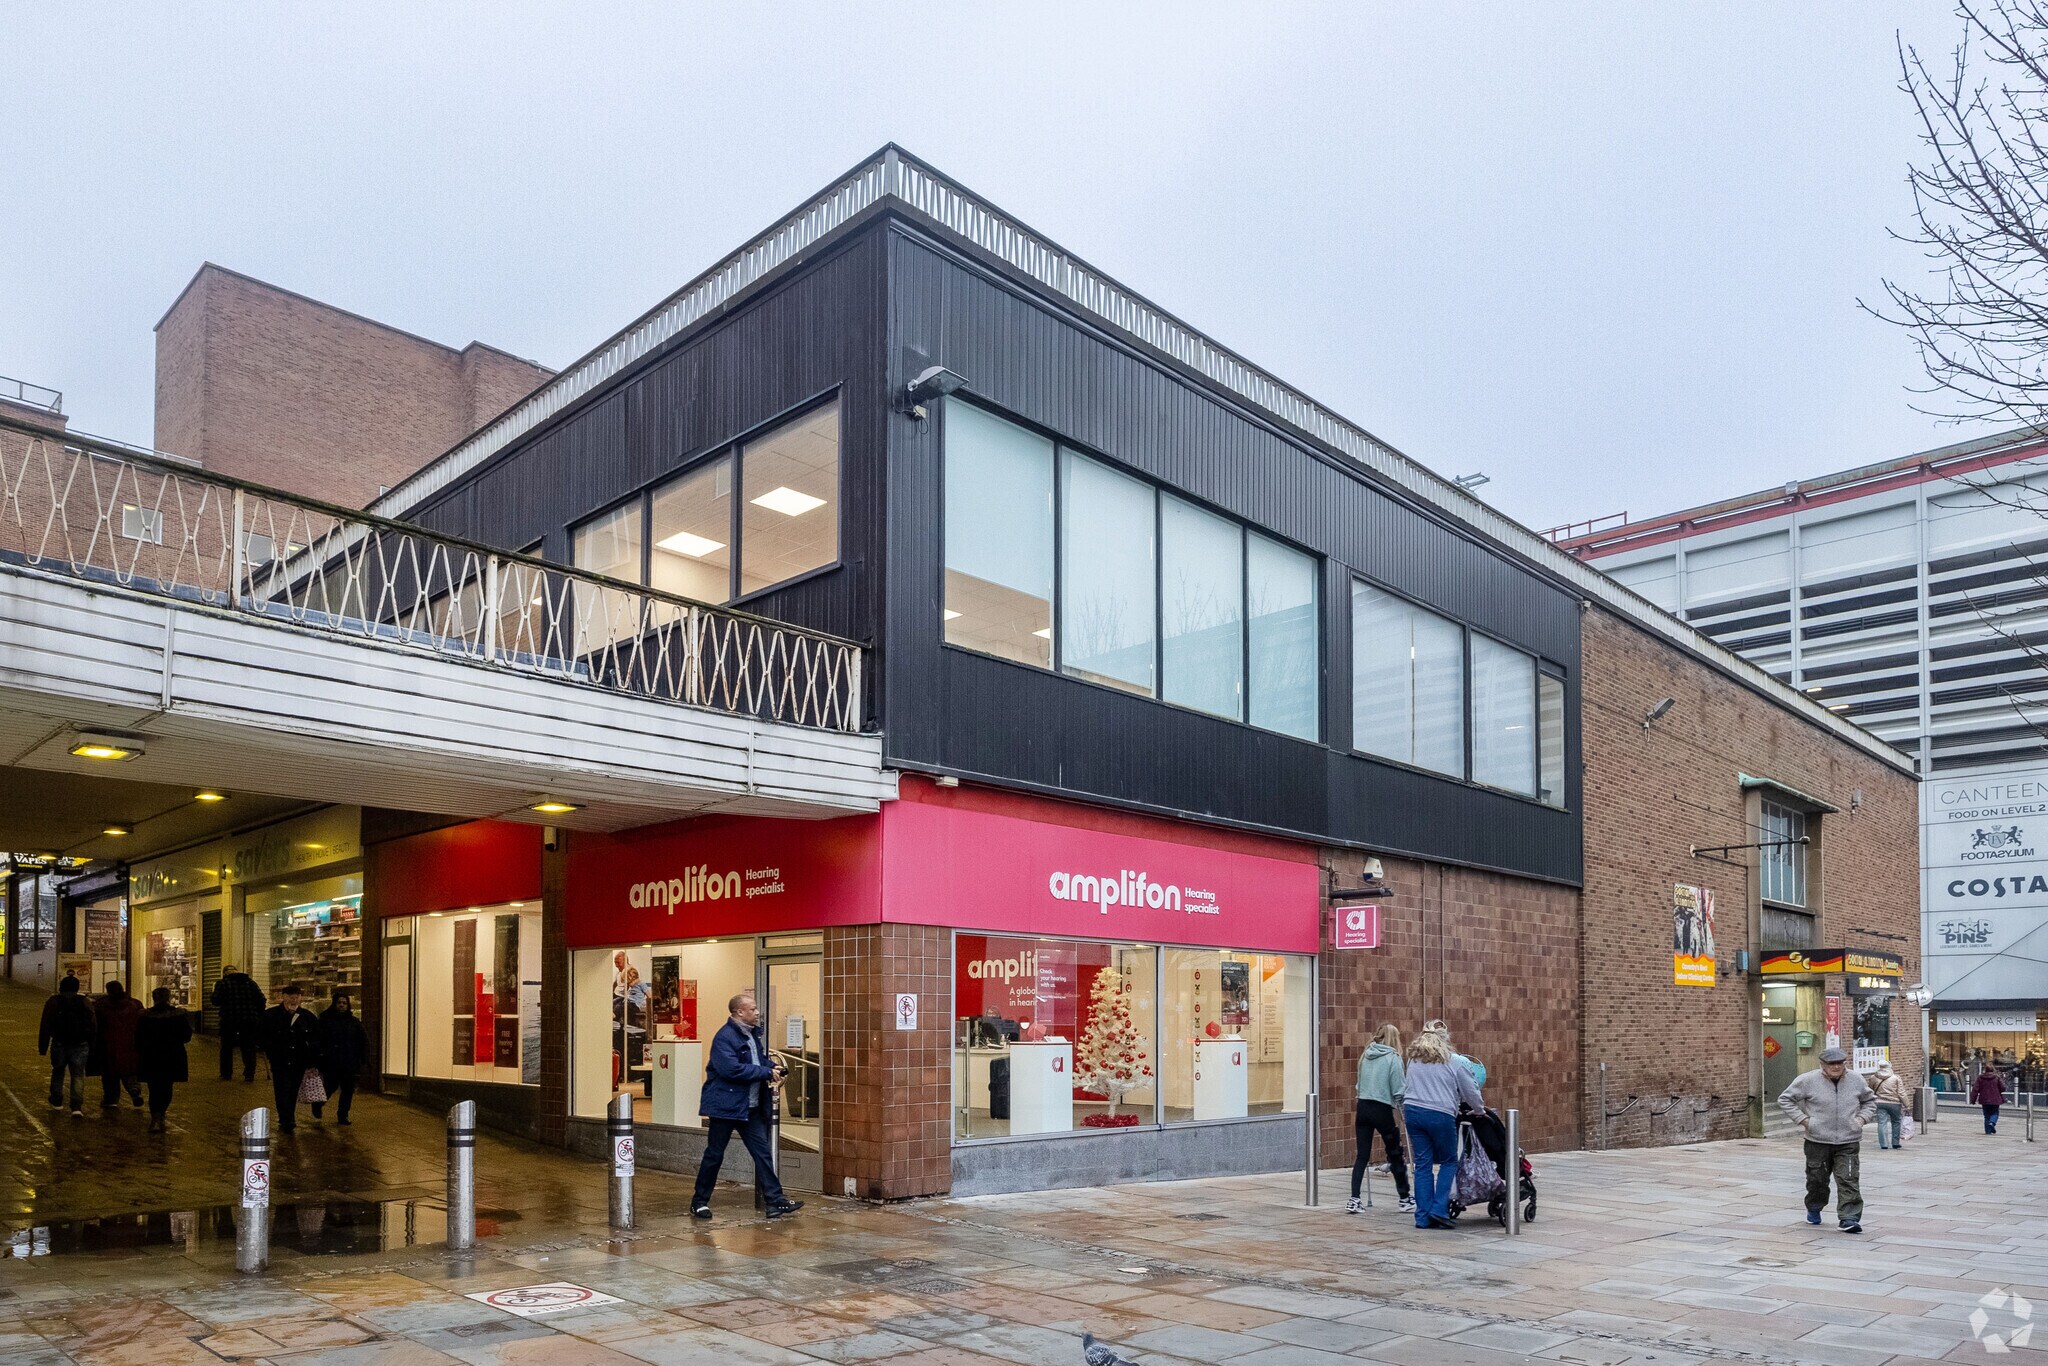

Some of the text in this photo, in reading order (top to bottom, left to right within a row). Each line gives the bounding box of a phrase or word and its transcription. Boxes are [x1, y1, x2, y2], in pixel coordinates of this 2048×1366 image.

[1941, 782, 2048, 804] CANTEEN
[1949, 804, 2046, 819] FOOD ON LEVEL 2
[14, 855, 47, 865] VAPES
[1961, 848, 2034, 860] FOOTASYLUM
[745, 866, 780, 880] Hearing
[629, 864, 741, 915] amplifon
[745, 882, 785, 899] specialist
[1049, 869, 1181, 914] amplifon
[1947, 875, 2048, 897] COSTA
[1184, 887, 1216, 902] Hearing
[1184, 902, 1220, 915] specialist
[1945, 932, 1988, 944] PINS
[1050, 975, 1067, 983] hearing
[1009, 987, 1015, 995] A
[1009, 998, 1016, 1007] in
[1941, 1017, 2031, 1026] BONMARCHE
